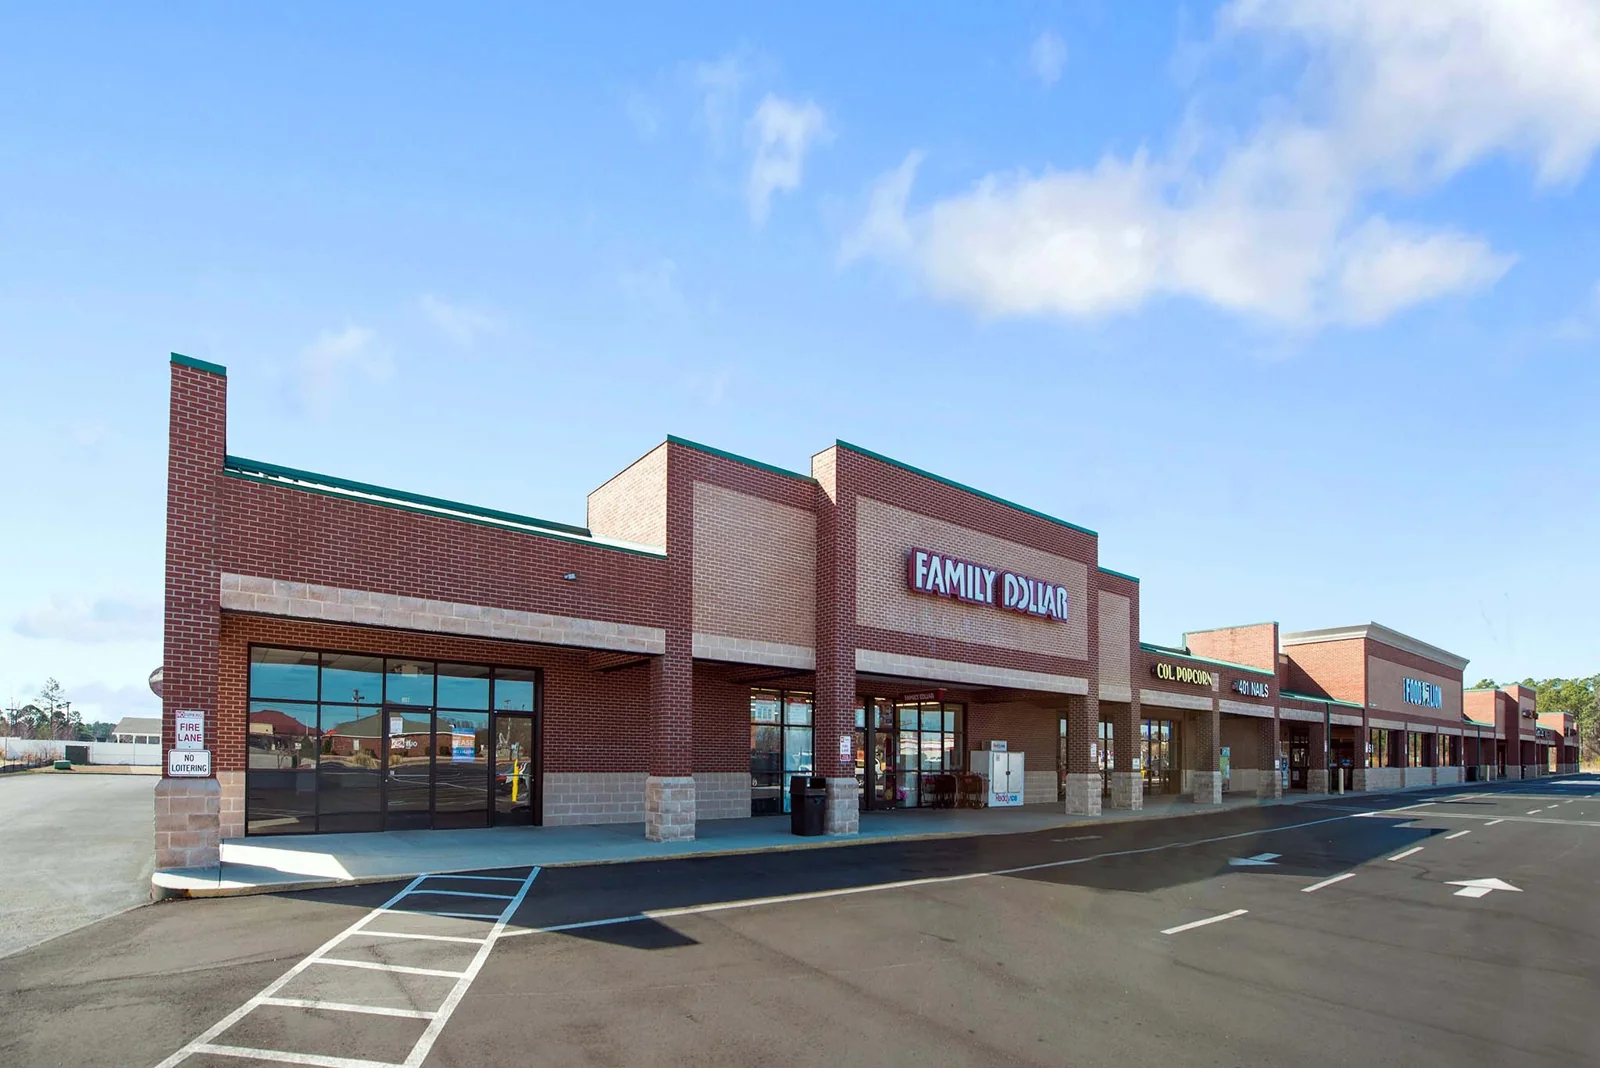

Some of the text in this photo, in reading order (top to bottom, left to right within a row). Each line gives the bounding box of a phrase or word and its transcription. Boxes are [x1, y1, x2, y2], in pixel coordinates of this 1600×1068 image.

[915, 550, 1069, 621] FAMILY DOLLAR
[1156, 662, 1213, 686] COL POPCORN
[1238, 679, 1270, 698] 401 NAILS
[180, 723, 200, 732] FIRE
[177, 733, 202, 742] LANE
[184, 754, 195, 762] NO
[171, 764, 207, 773] LOITERING
